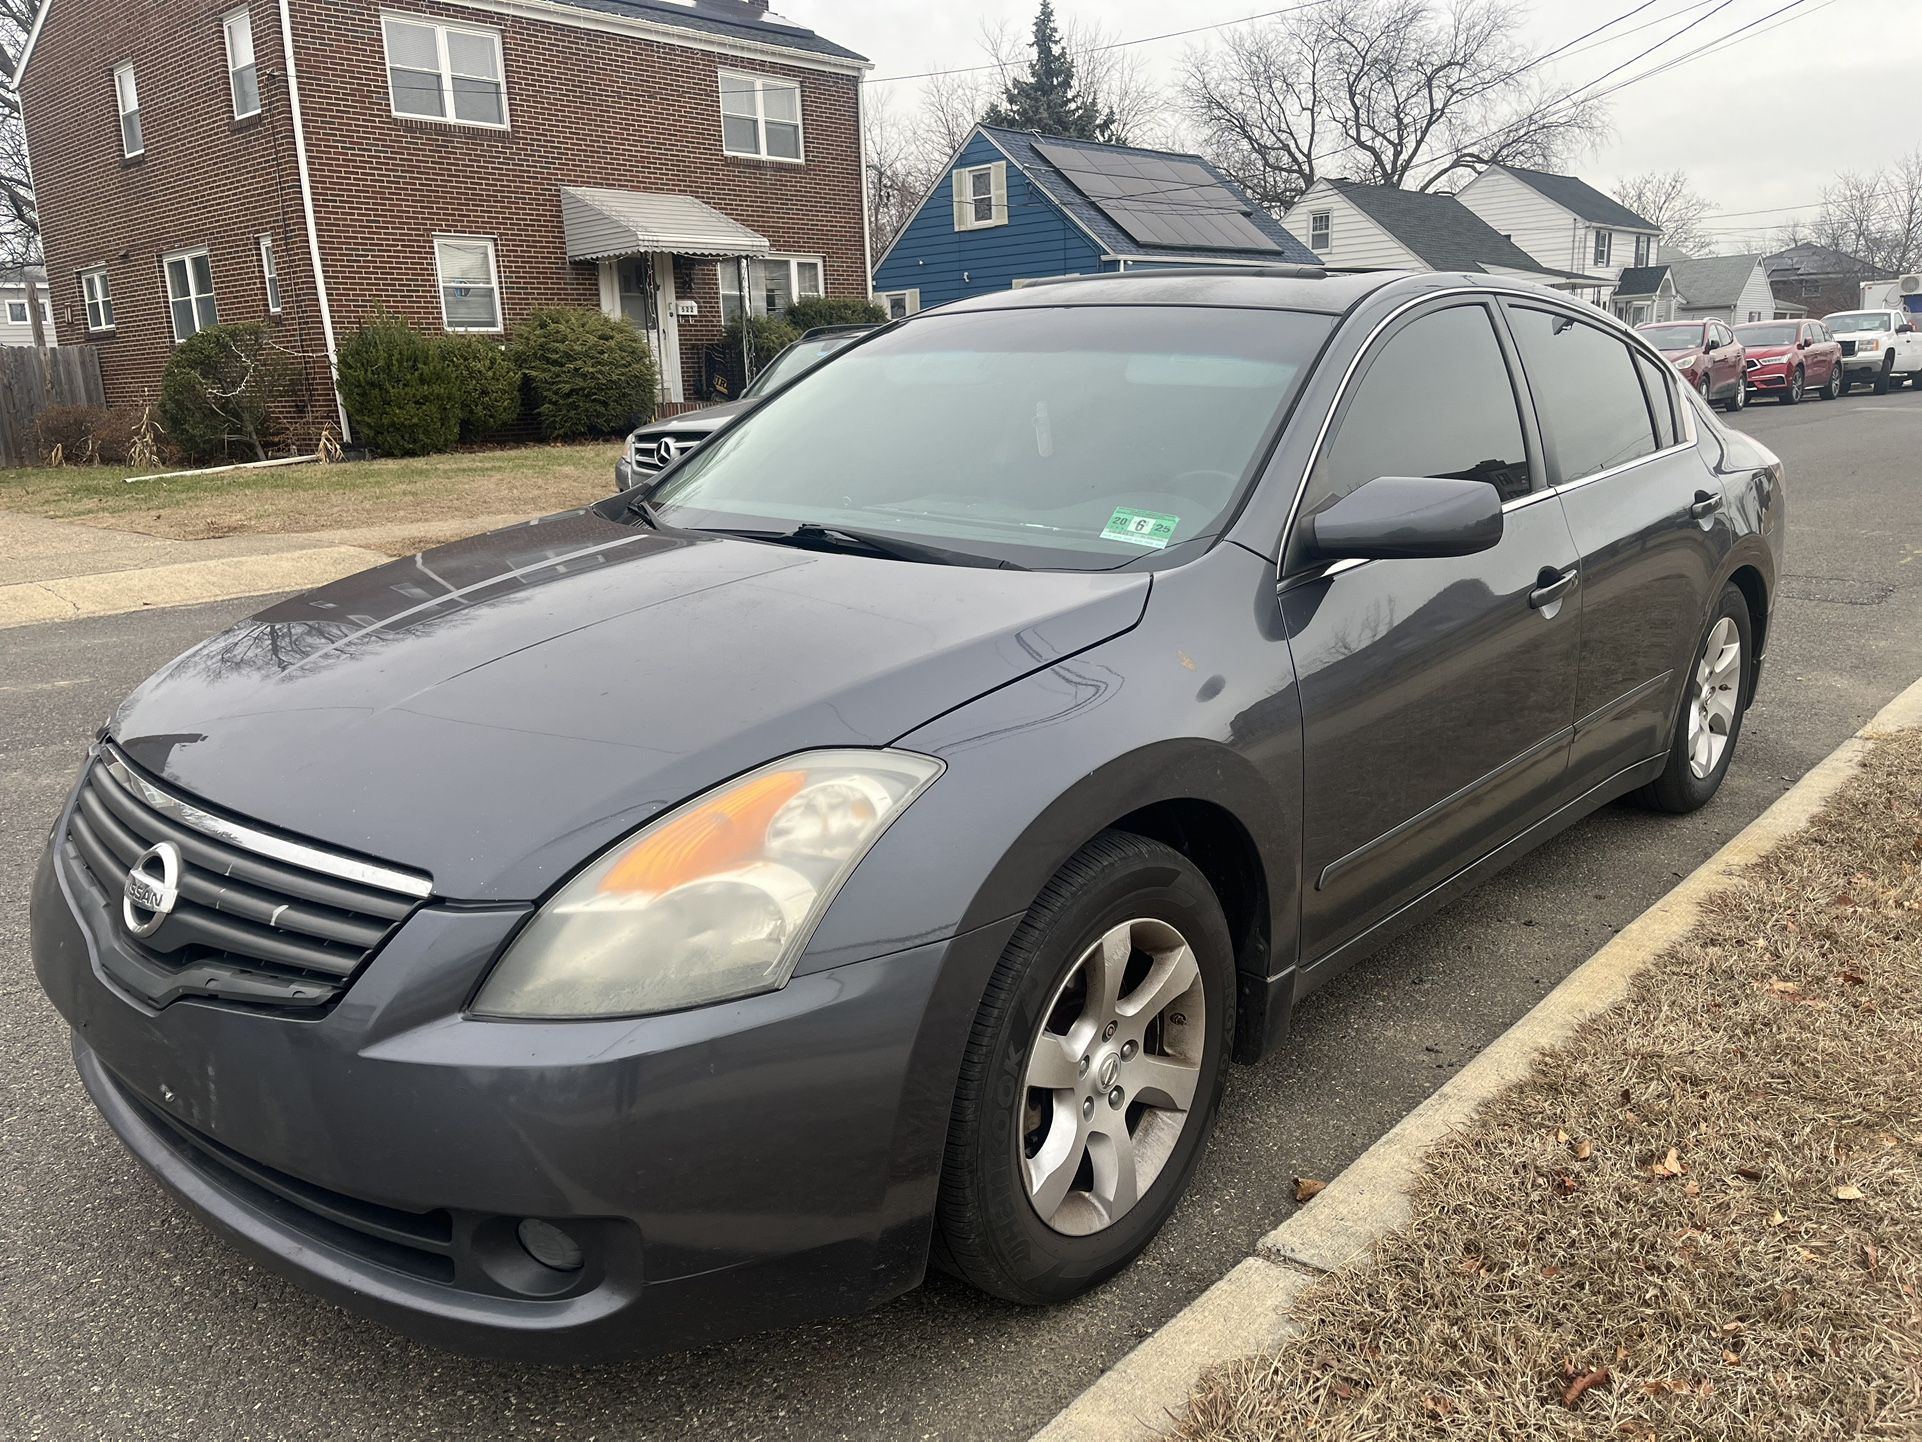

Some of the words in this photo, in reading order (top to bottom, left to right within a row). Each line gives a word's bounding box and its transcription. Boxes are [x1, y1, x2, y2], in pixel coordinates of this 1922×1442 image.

[1112, 517, 1128, 526] 20
[1135, 519, 1147, 532] 6
[1155, 524, 1170, 533] 25
[126, 880, 163, 907] SSAN
